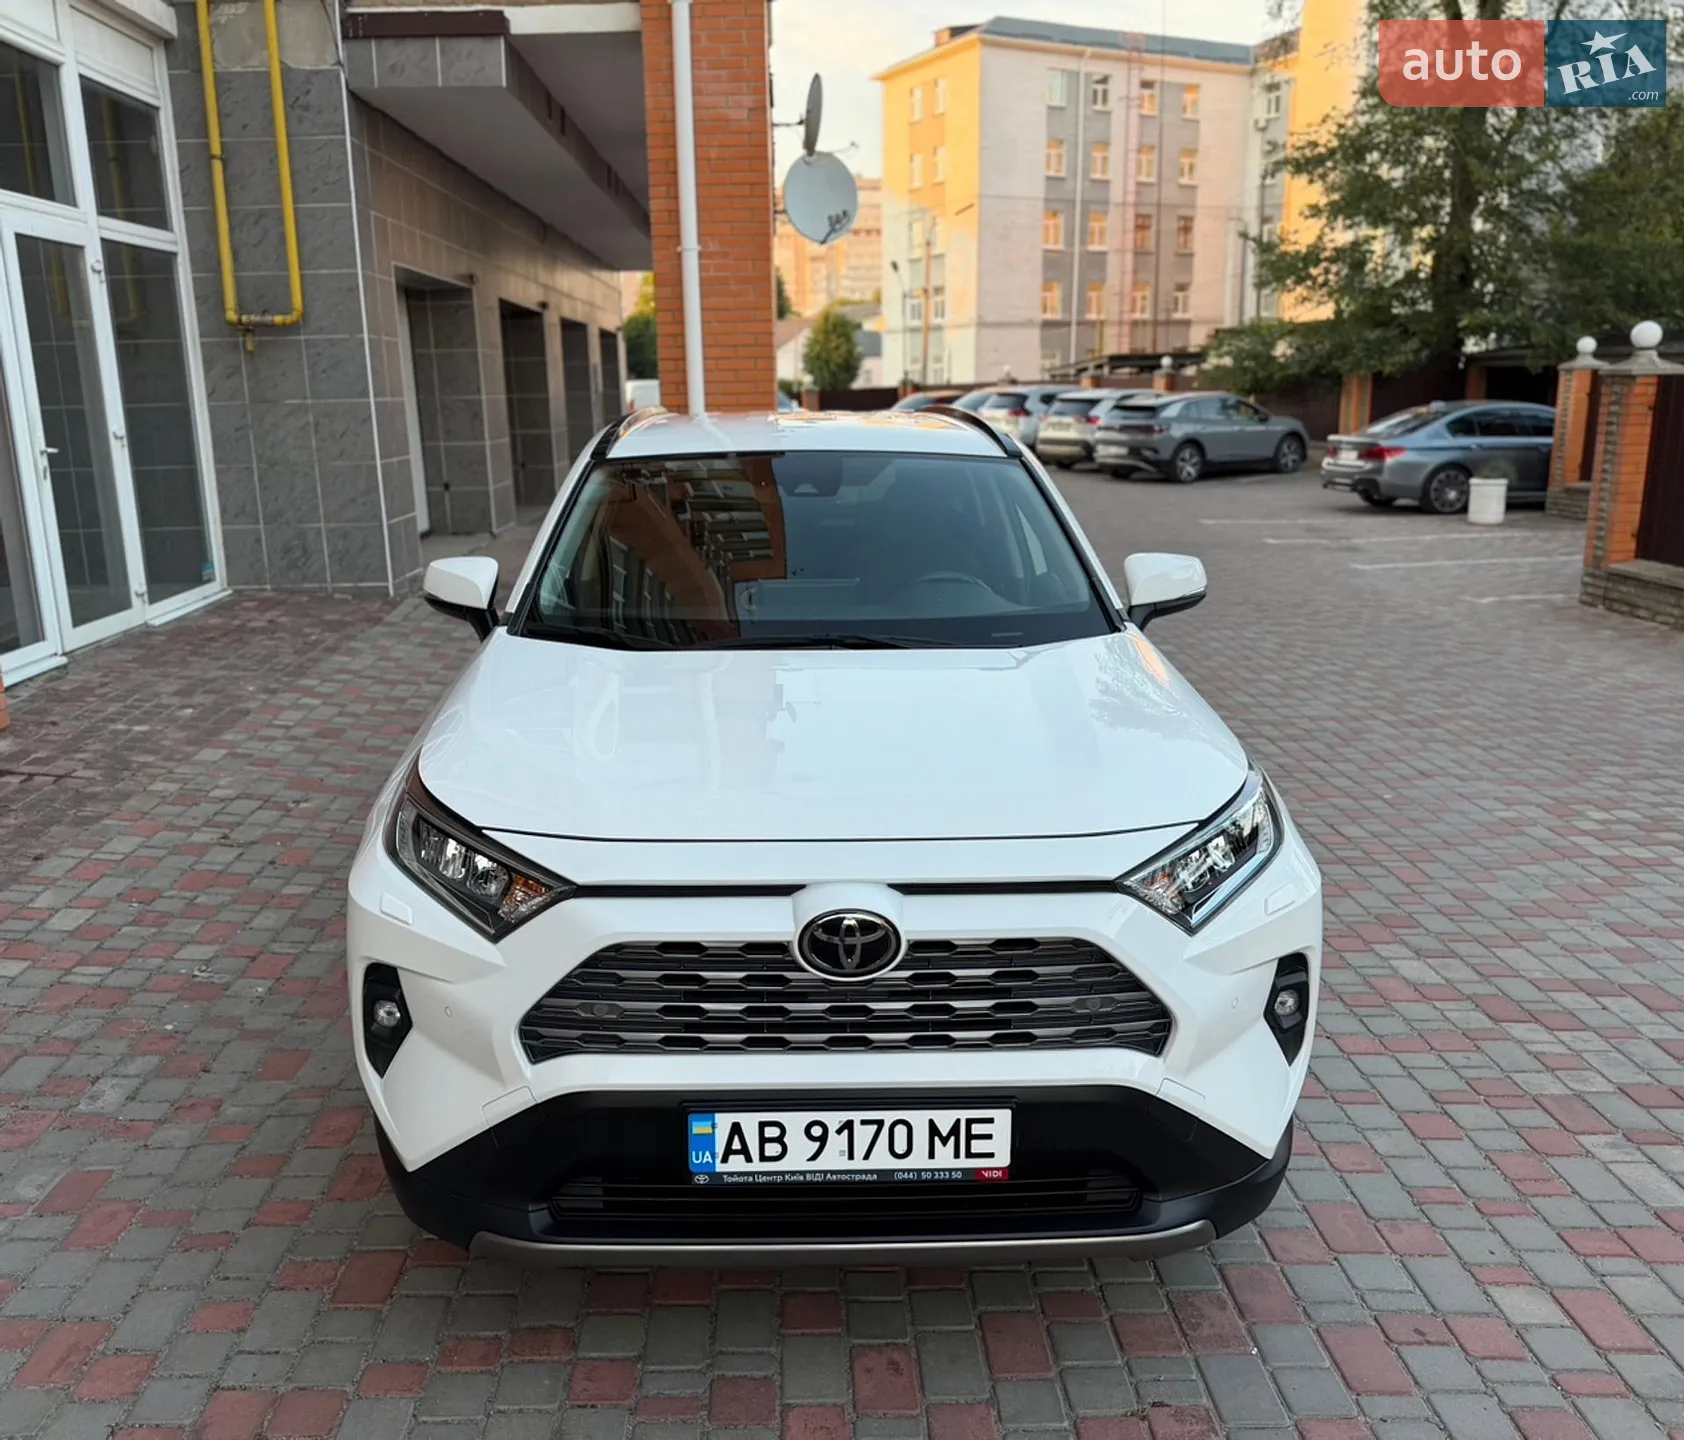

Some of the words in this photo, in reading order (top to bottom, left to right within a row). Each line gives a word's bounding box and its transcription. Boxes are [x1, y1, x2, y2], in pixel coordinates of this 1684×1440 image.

[720, 1120, 788, 1163] AB
[804, 1118, 913, 1161] 9170
[928, 1117, 995, 1159] ME
[692, 1151, 713, 1164] UA
[755, 1174, 783, 1183] Центр
[826, 1172, 877, 1182] Автострада
[894, 1171, 917, 1180] (044)
[921, 1171, 932, 1180] 50
[934, 1171, 949, 1179] 333
[951, 1170, 963, 1179] 50
